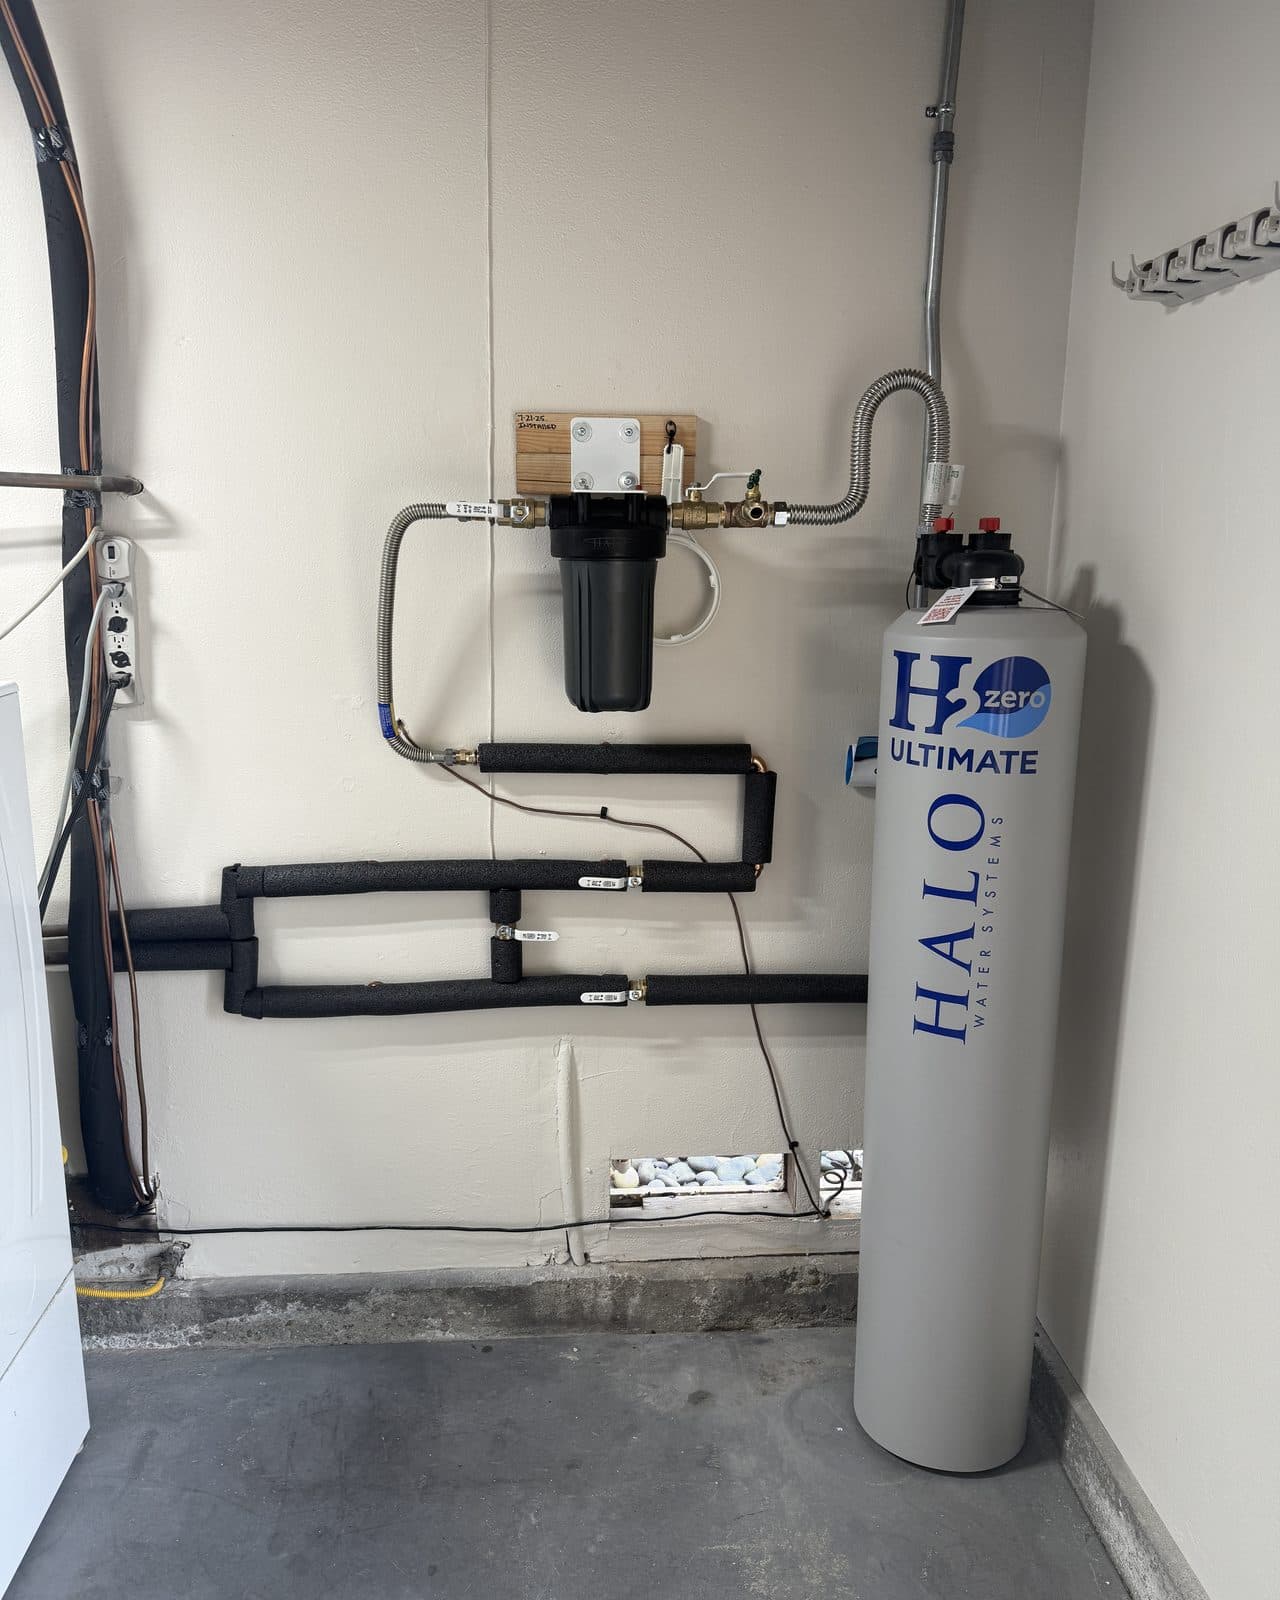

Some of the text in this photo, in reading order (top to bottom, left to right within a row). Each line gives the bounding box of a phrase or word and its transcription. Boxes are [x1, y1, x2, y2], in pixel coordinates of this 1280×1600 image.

[890, 737, 1039, 775] ULTIMATE
[984, 689, 1045, 709] zero
[912, 793, 986, 1046] HALO
[973, 816, 1004, 1029] WATER SYSTEMS
